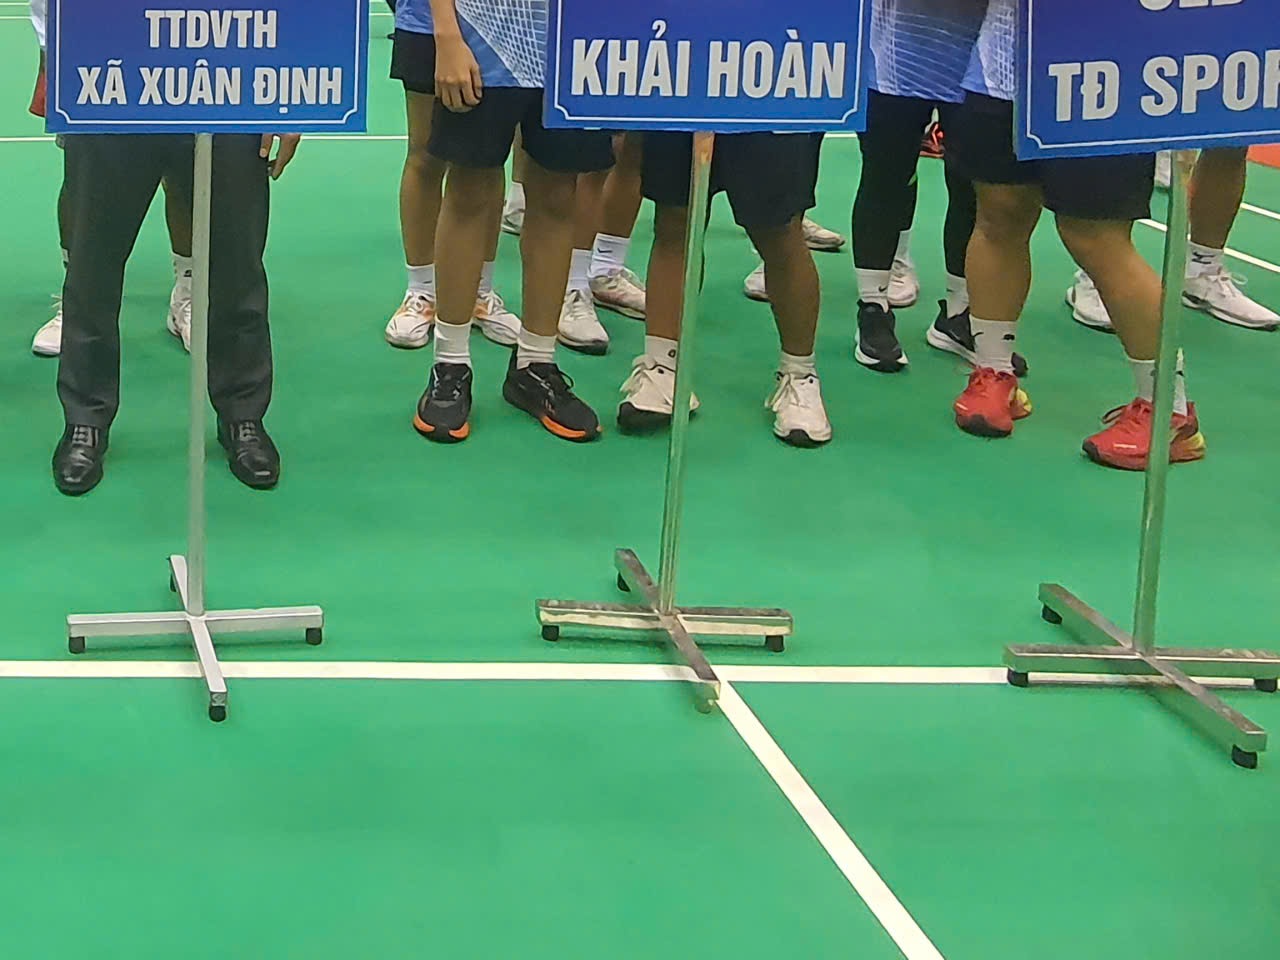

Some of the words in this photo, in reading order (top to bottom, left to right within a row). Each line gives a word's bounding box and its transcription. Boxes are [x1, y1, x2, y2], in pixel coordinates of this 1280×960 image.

[145, 9, 278, 49] TTDVTH
[76, 58, 128, 106] XÃ
[138, 58, 242, 106] XUÂN
[252, 66, 343, 114] ĐỊNH
[571, 19, 691, 97] KHẢI
[706, 29, 847, 99] HOÀN
[1047, 60, 1120, 122] TĐ
